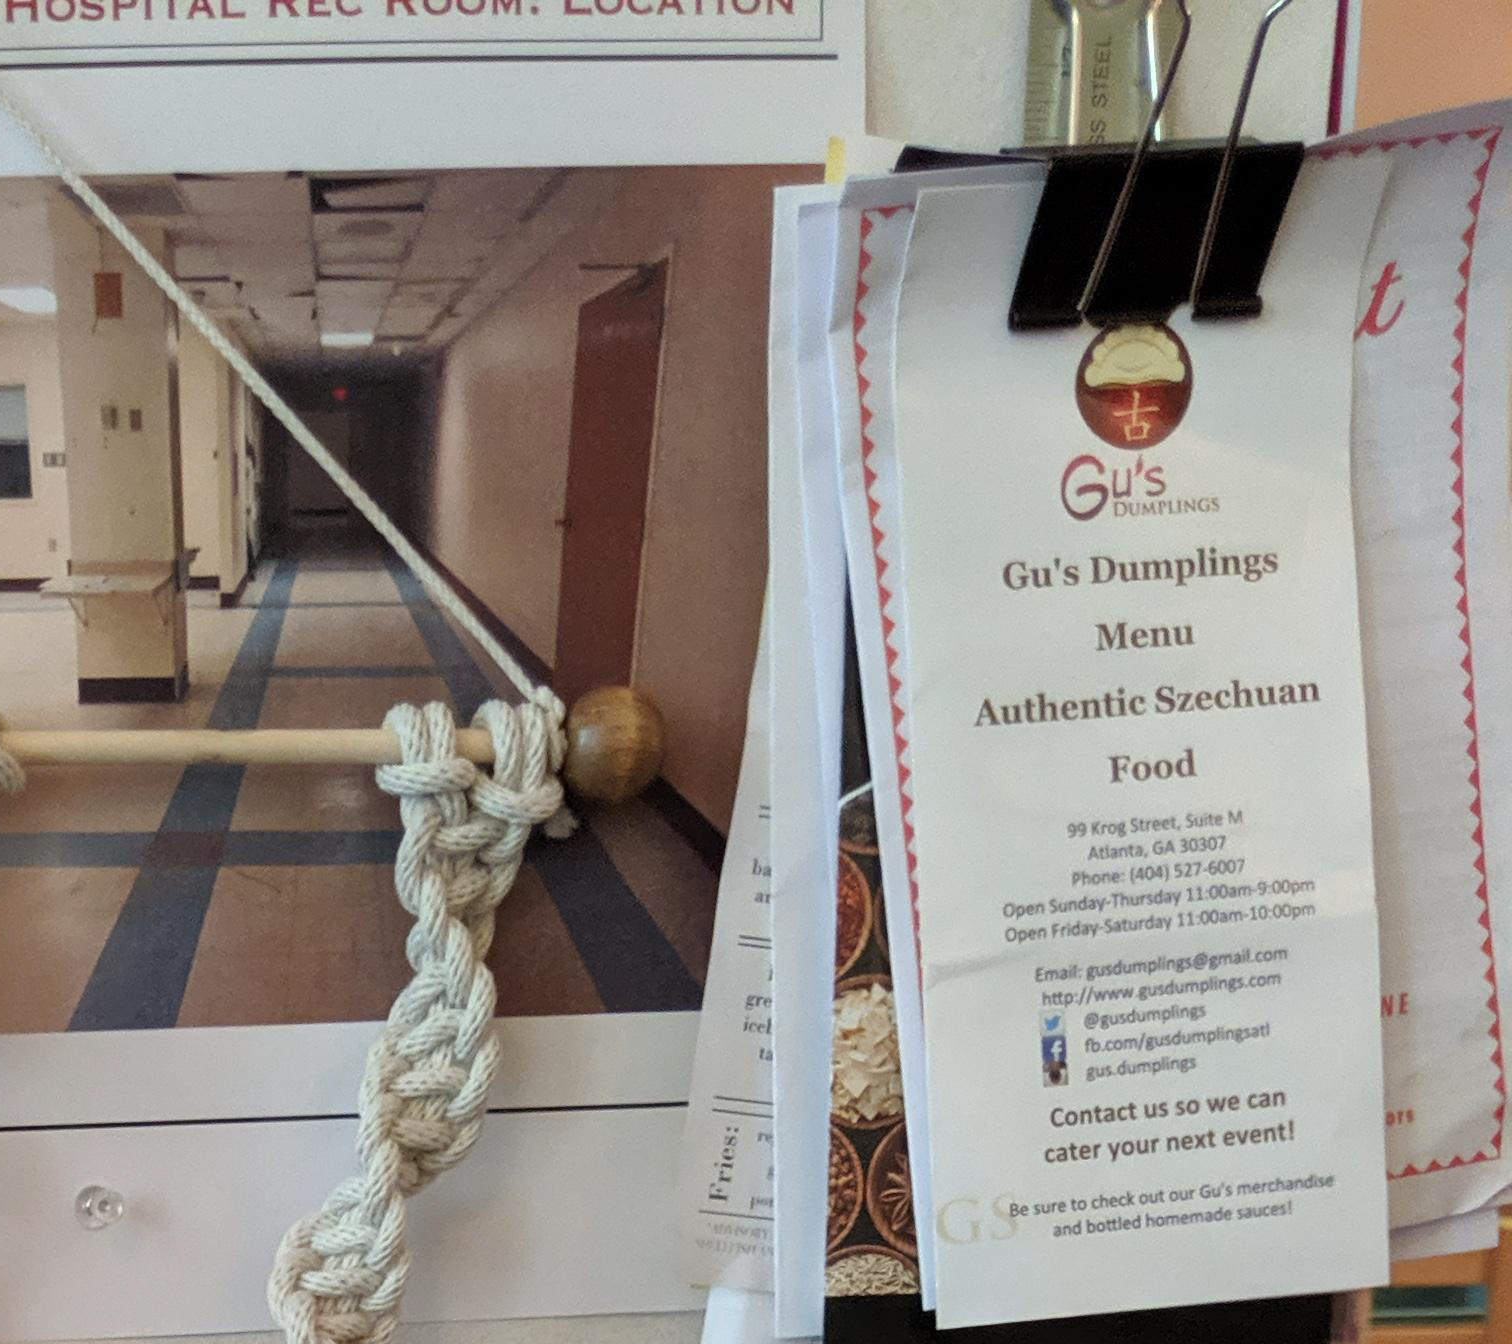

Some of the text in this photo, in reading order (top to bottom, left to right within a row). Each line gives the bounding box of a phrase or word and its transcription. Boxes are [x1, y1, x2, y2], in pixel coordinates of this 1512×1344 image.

[1091, 37, 1111, 109] STEEL
[1003, 547, 1278, 590] Gu's Dumplings
[1096, 622, 1194, 651] Menu
[975, 680, 1320, 726] Authentic Szechuan
[1109, 748, 1196, 782] Food
[1067, 810, 1243, 838] 99 Krog Street, Suite M
[1088, 835, 1226, 860] Atlanta, GA 30307
[1072, 858, 1245, 886] Phone: (404) 527-6007
[1003, 879, 1315, 920] Open Sunday-Thursday 11:00am-9:00pm
[1005, 903, 1315, 943] Open Friday-Saturday 11:00am-10:00pm
[1035, 947, 1288, 982] Email: gusdumplings@gmail.com
[1041, 971, 1282, 1007] http://www.gusdumplings.com
[1084, 1005, 1206, 1030] @gusdumplings
[1084, 1022, 1271, 1053] fb.com/gusdumplingsatl
[1086, 1057, 1197, 1082] gus.dumplings
[1050, 1092, 1286, 1127] Contact us so we can
[1045, 1120, 1294, 1163] cater your next event!
[708, 1125, 740, 1203] Fries:
[1009, 1174, 1335, 1219] Be sure to check out our Gu's merchandise
[1053, 1200, 1292, 1237] and bottled homemade sauces!
